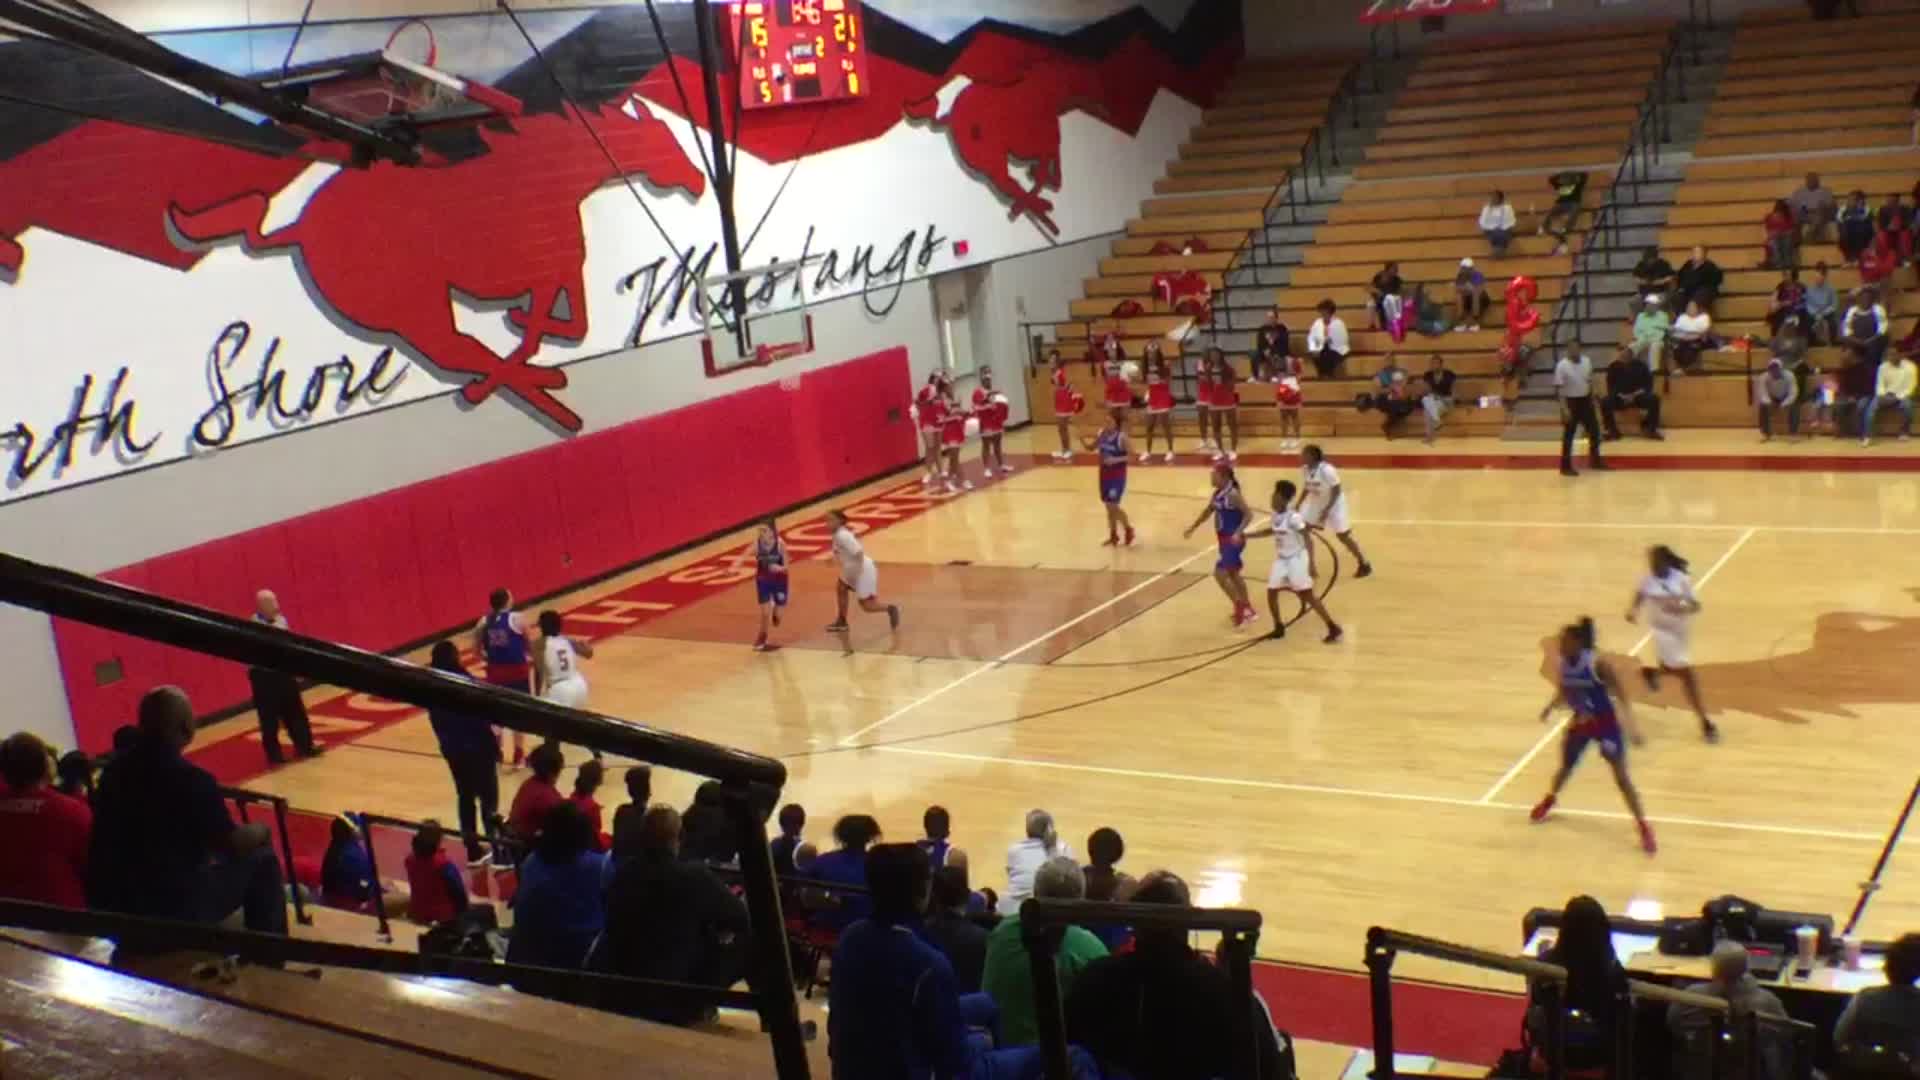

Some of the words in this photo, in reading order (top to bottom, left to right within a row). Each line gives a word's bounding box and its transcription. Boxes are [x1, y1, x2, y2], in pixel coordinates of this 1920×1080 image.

[833, 13, 856, 43] 21
[760, 81, 773, 104] 5
[622, 225, 947, 347] Mustangs
[0, 366, 162, 482] rth
[193, 321, 410, 448] Shore
[557, 649, 570, 673] 5
